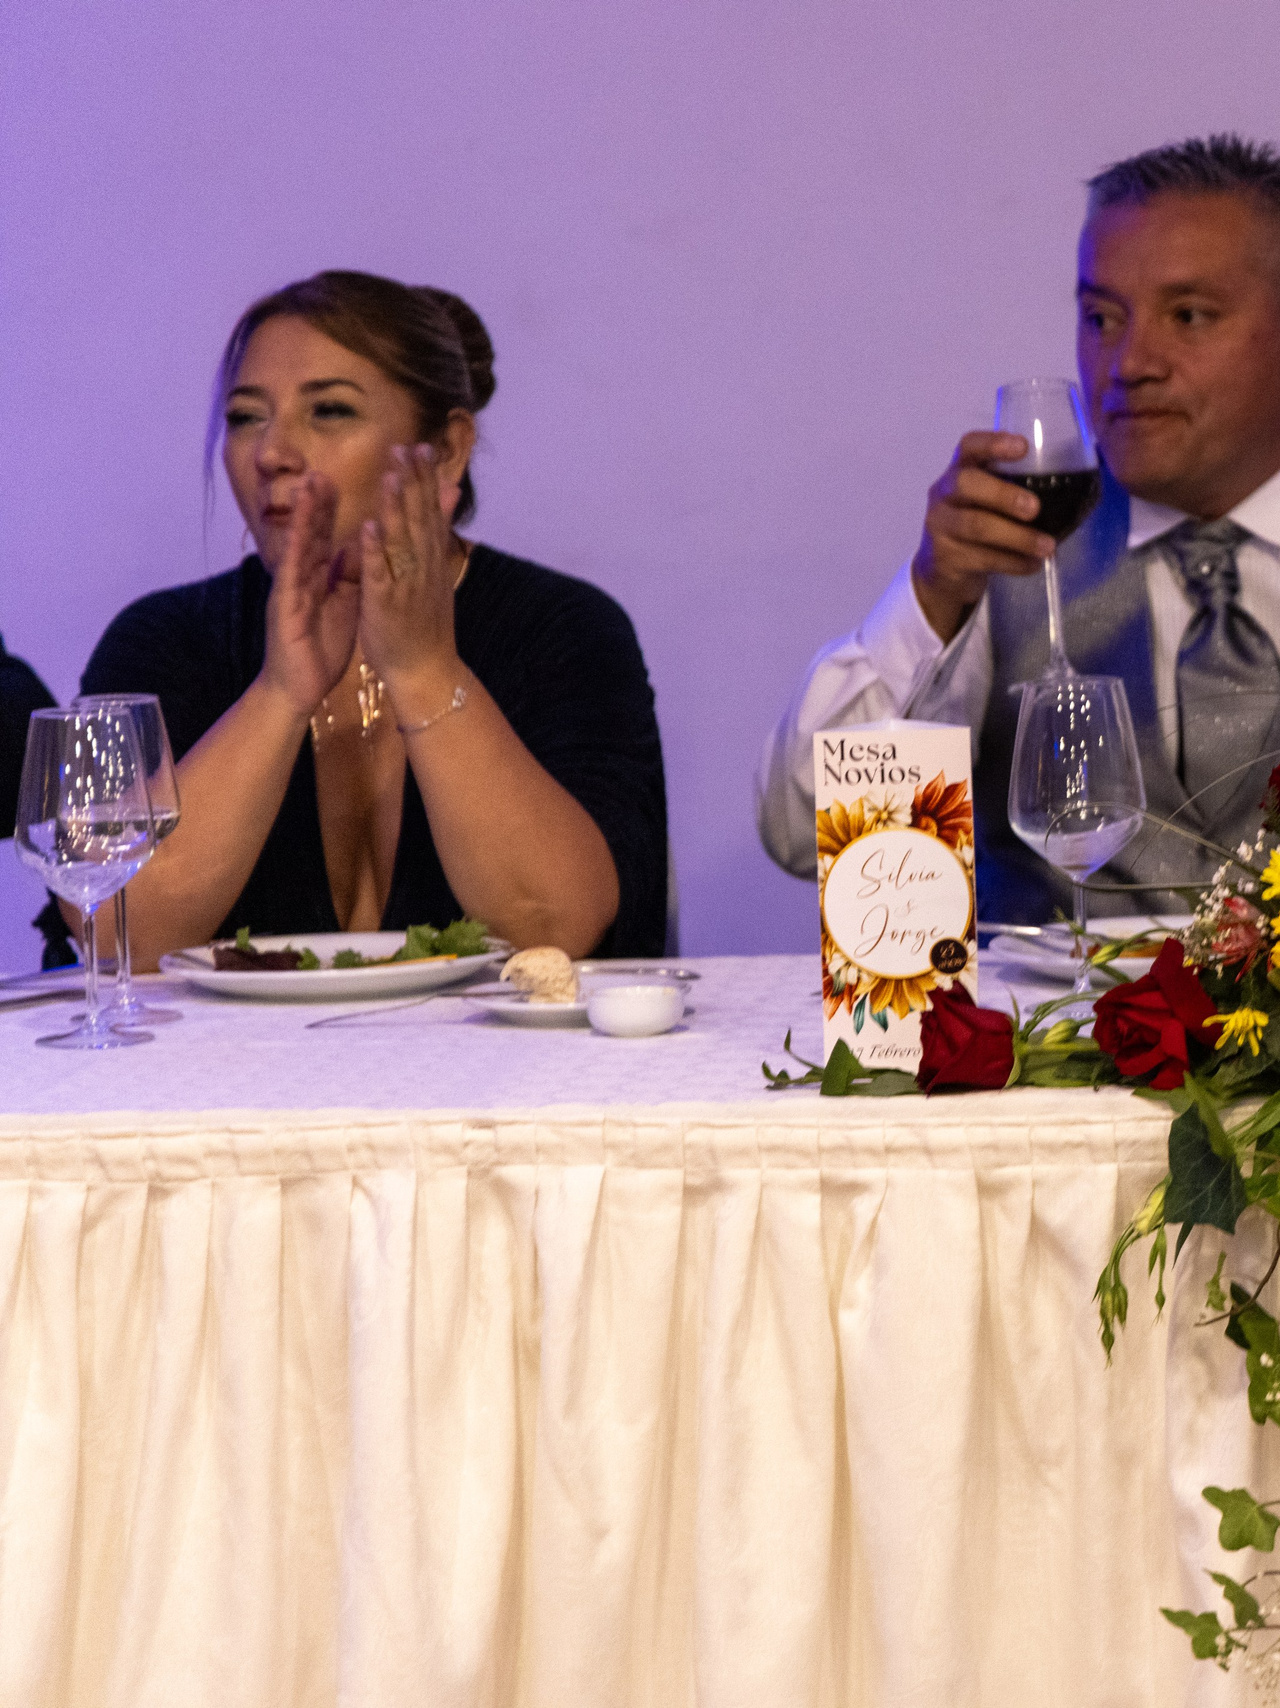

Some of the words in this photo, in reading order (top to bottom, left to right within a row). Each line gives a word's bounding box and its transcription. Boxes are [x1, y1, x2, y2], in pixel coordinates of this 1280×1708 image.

[823, 738, 897, 763] Mesa
[823, 762, 922, 786] Novios
[856, 847, 943, 899] Silvia
[854, 902, 945, 959] Jorge
[869, 1043, 921, 1059] Febrero
